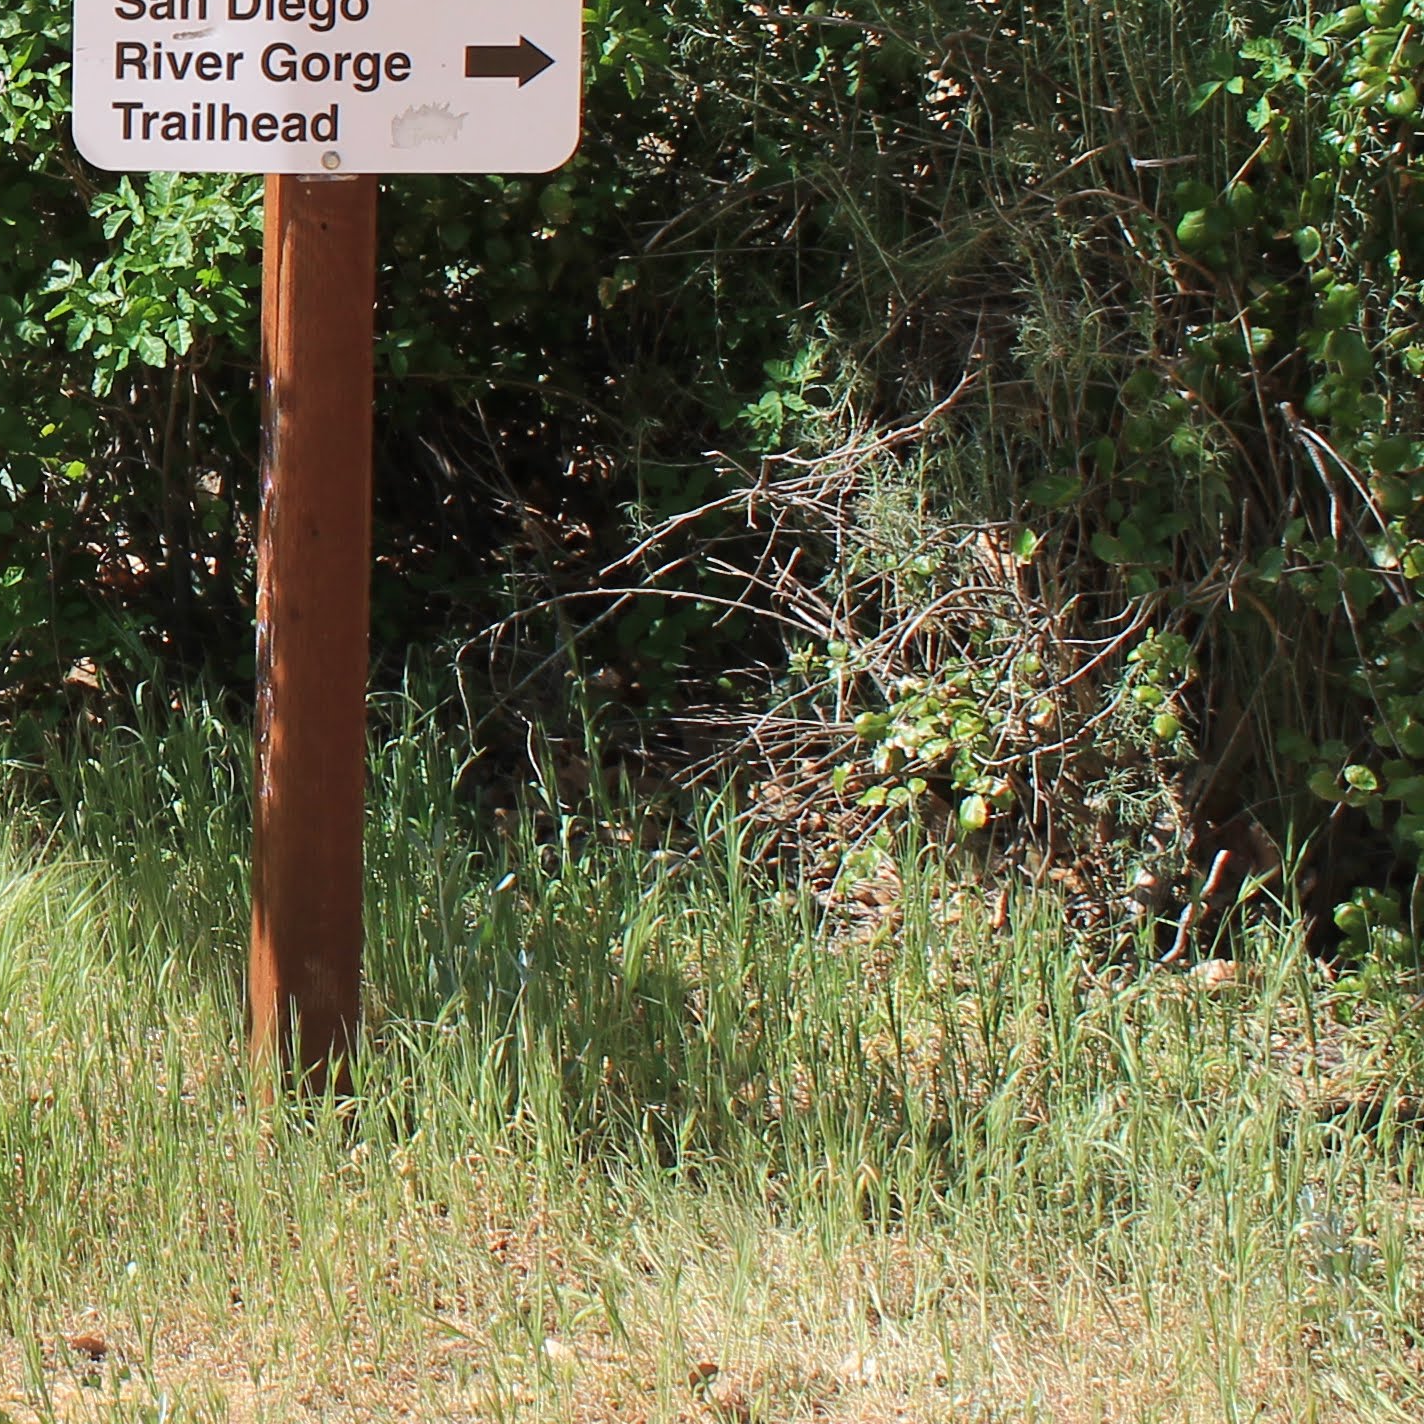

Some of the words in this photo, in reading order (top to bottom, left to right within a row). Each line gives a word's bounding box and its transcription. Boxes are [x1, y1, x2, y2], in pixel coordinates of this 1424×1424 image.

[115, 41, 244, 81] River
[261, 42, 411, 92] Gorge
[112, 102, 338, 142] Trailhead
